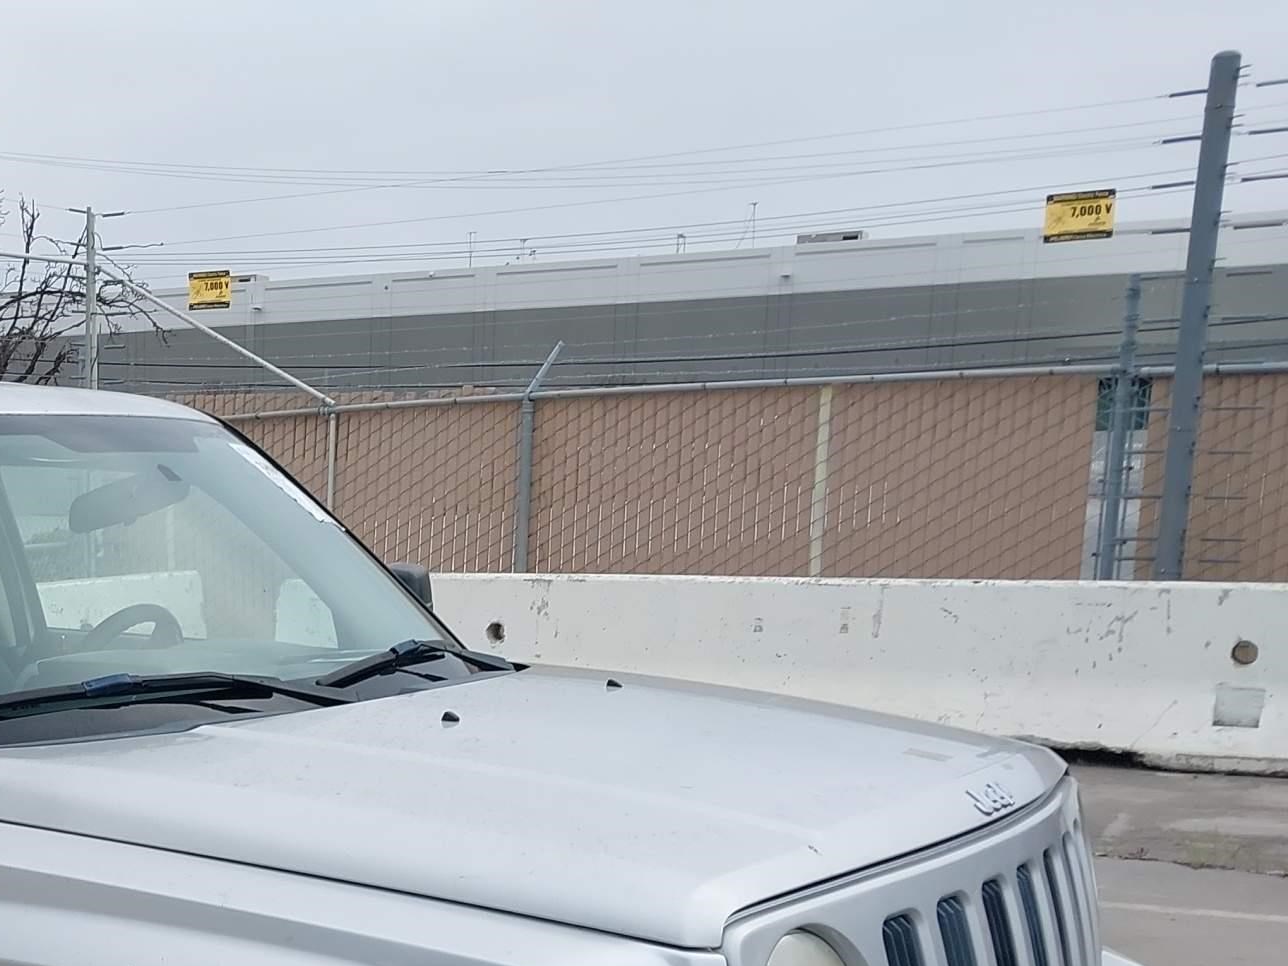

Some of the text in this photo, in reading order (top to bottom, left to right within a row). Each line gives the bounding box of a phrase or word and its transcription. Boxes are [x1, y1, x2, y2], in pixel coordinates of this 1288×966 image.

[1071, 204, 1102, 218] 7,000
[1106, 203, 1113, 214] V
[204, 281, 223, 292] 7,000
